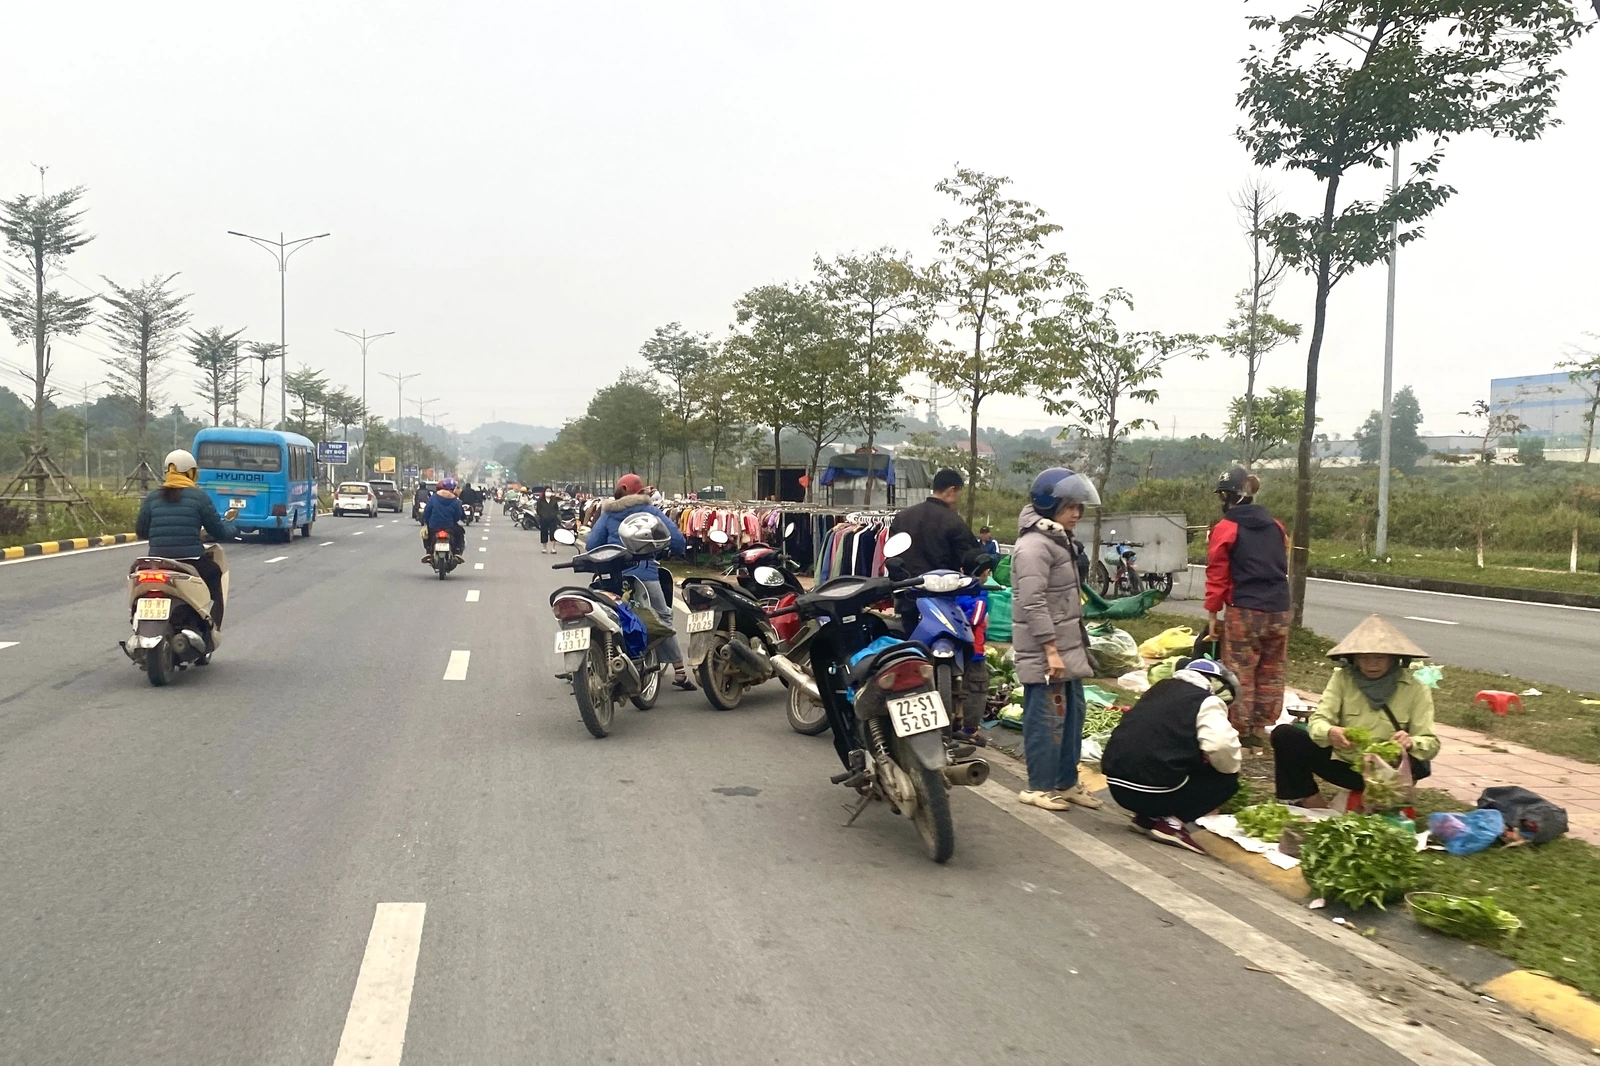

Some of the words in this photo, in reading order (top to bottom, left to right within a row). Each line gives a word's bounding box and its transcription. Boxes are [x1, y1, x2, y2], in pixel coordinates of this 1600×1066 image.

[216, 472, 264, 482] HYUNDAI
[562, 629, 584, 640] 19-E1
[557, 638, 587, 651] 433.17
[896, 695, 935, 717] 22-S1
[900, 710, 938, 732] 5267
